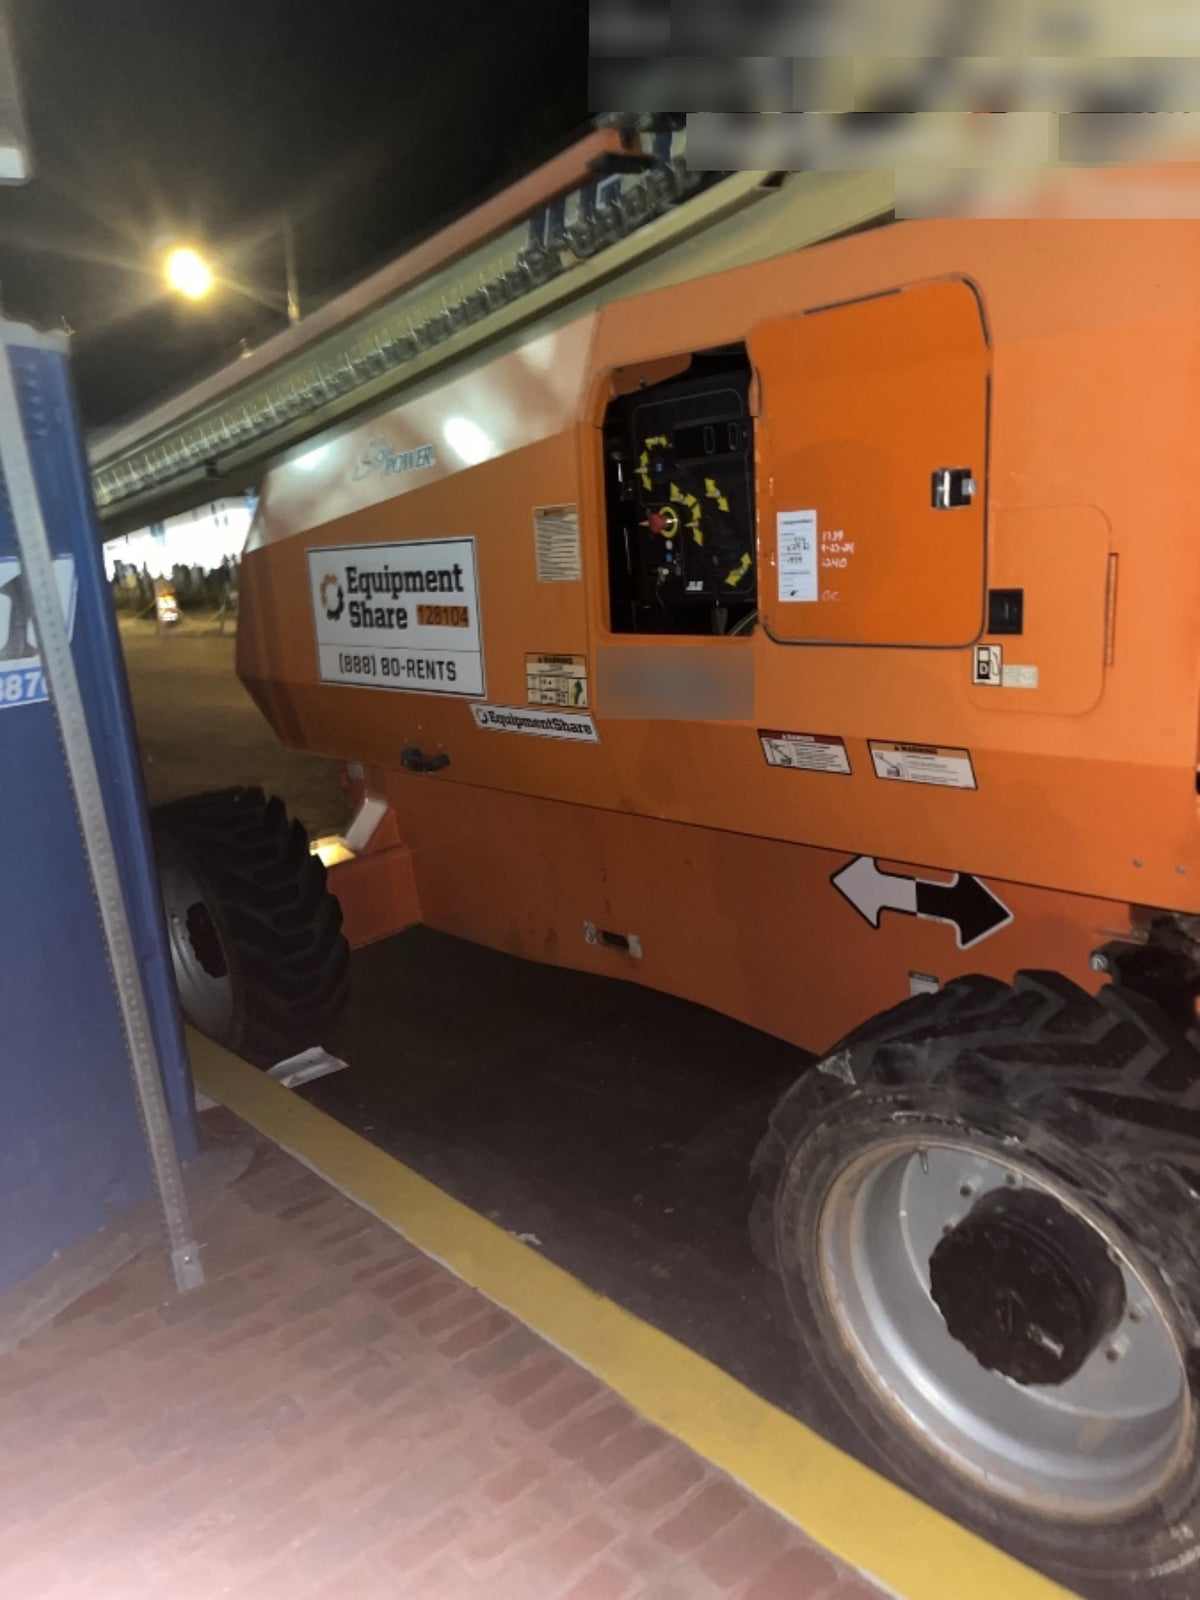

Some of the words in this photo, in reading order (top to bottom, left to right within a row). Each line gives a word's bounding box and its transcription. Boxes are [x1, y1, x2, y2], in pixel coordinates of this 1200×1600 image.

[345, 563, 464, 600] Equipment
[349, 601, 408, 629] Share
[417, 605, 469, 626] 128104
[338, 653, 376, 676] (888)
[381, 656, 457, 682] 80-RENTS
[0, 670, 48, 704] 87
[487, 711, 593, 735] EquipmentShare
